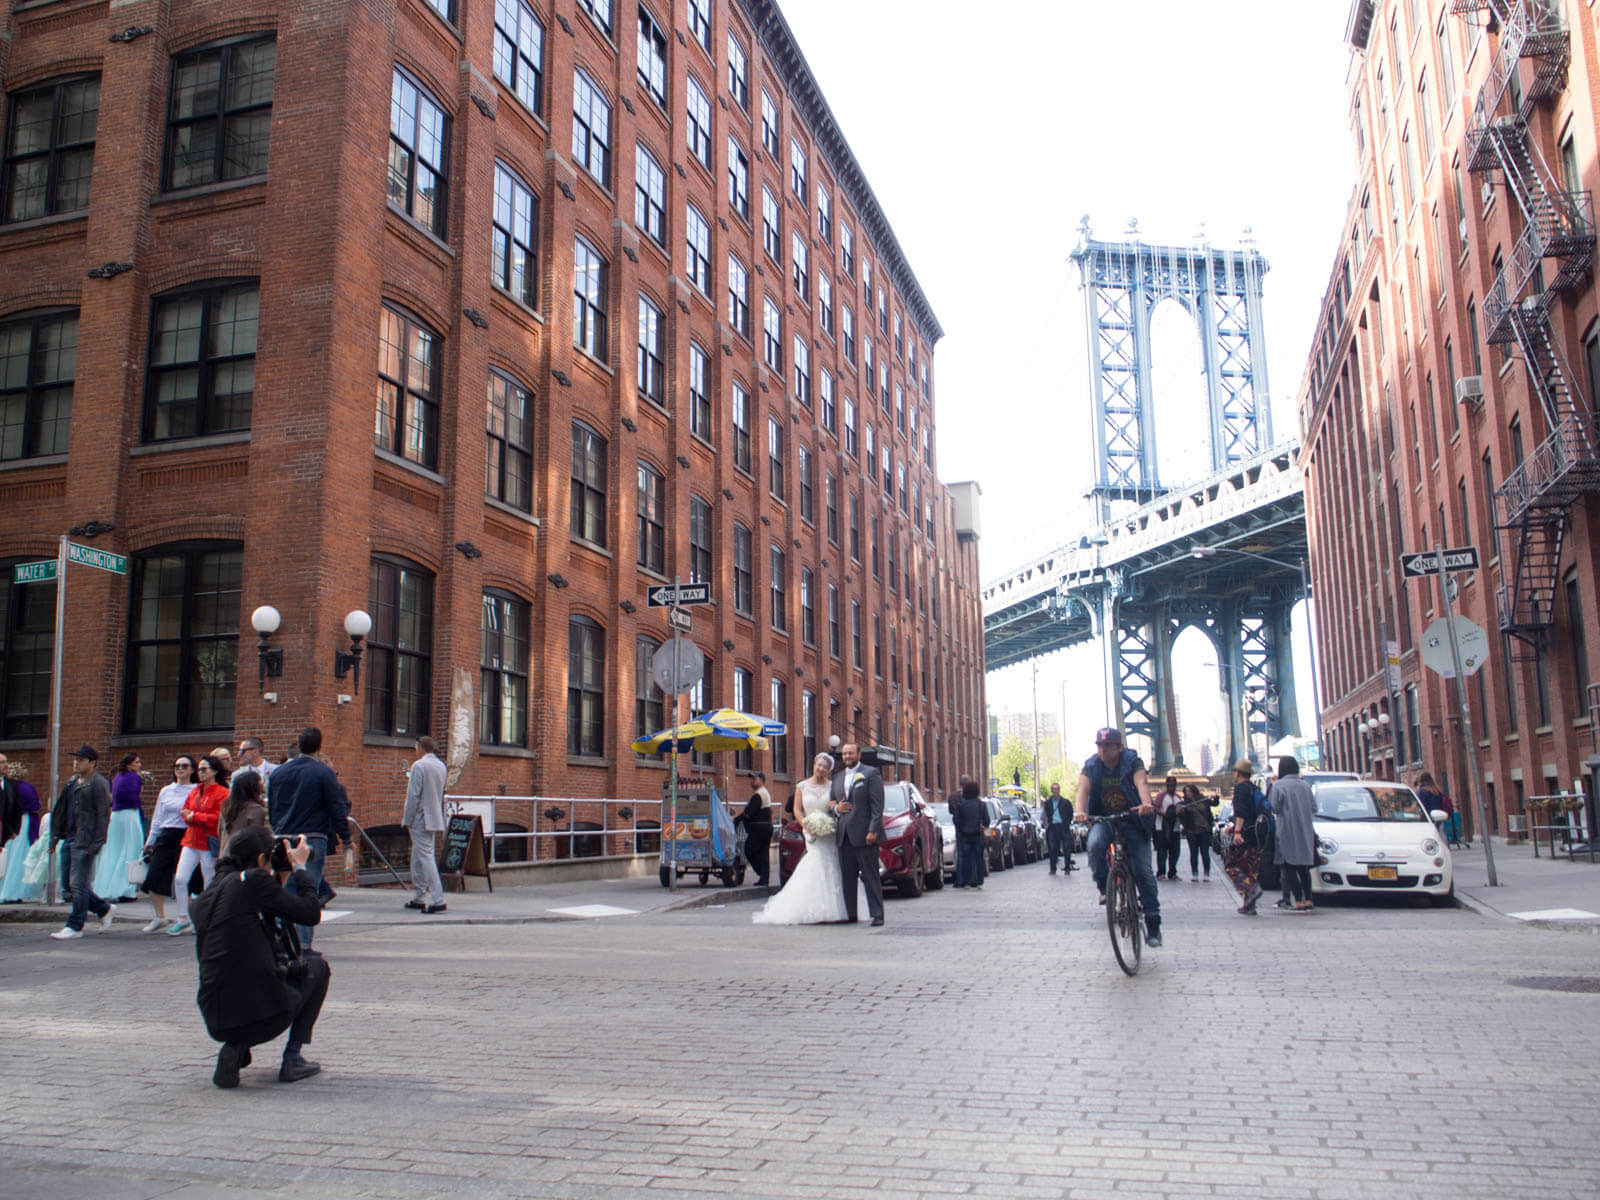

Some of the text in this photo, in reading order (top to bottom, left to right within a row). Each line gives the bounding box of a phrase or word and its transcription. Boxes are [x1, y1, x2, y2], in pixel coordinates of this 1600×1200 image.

[70, 546, 117, 570] WASHINGTON
[1414, 554, 1468, 570] ONE WAY
[16, 565, 45, 581] WATER
[657, 590, 701, 601] ONE WAY
